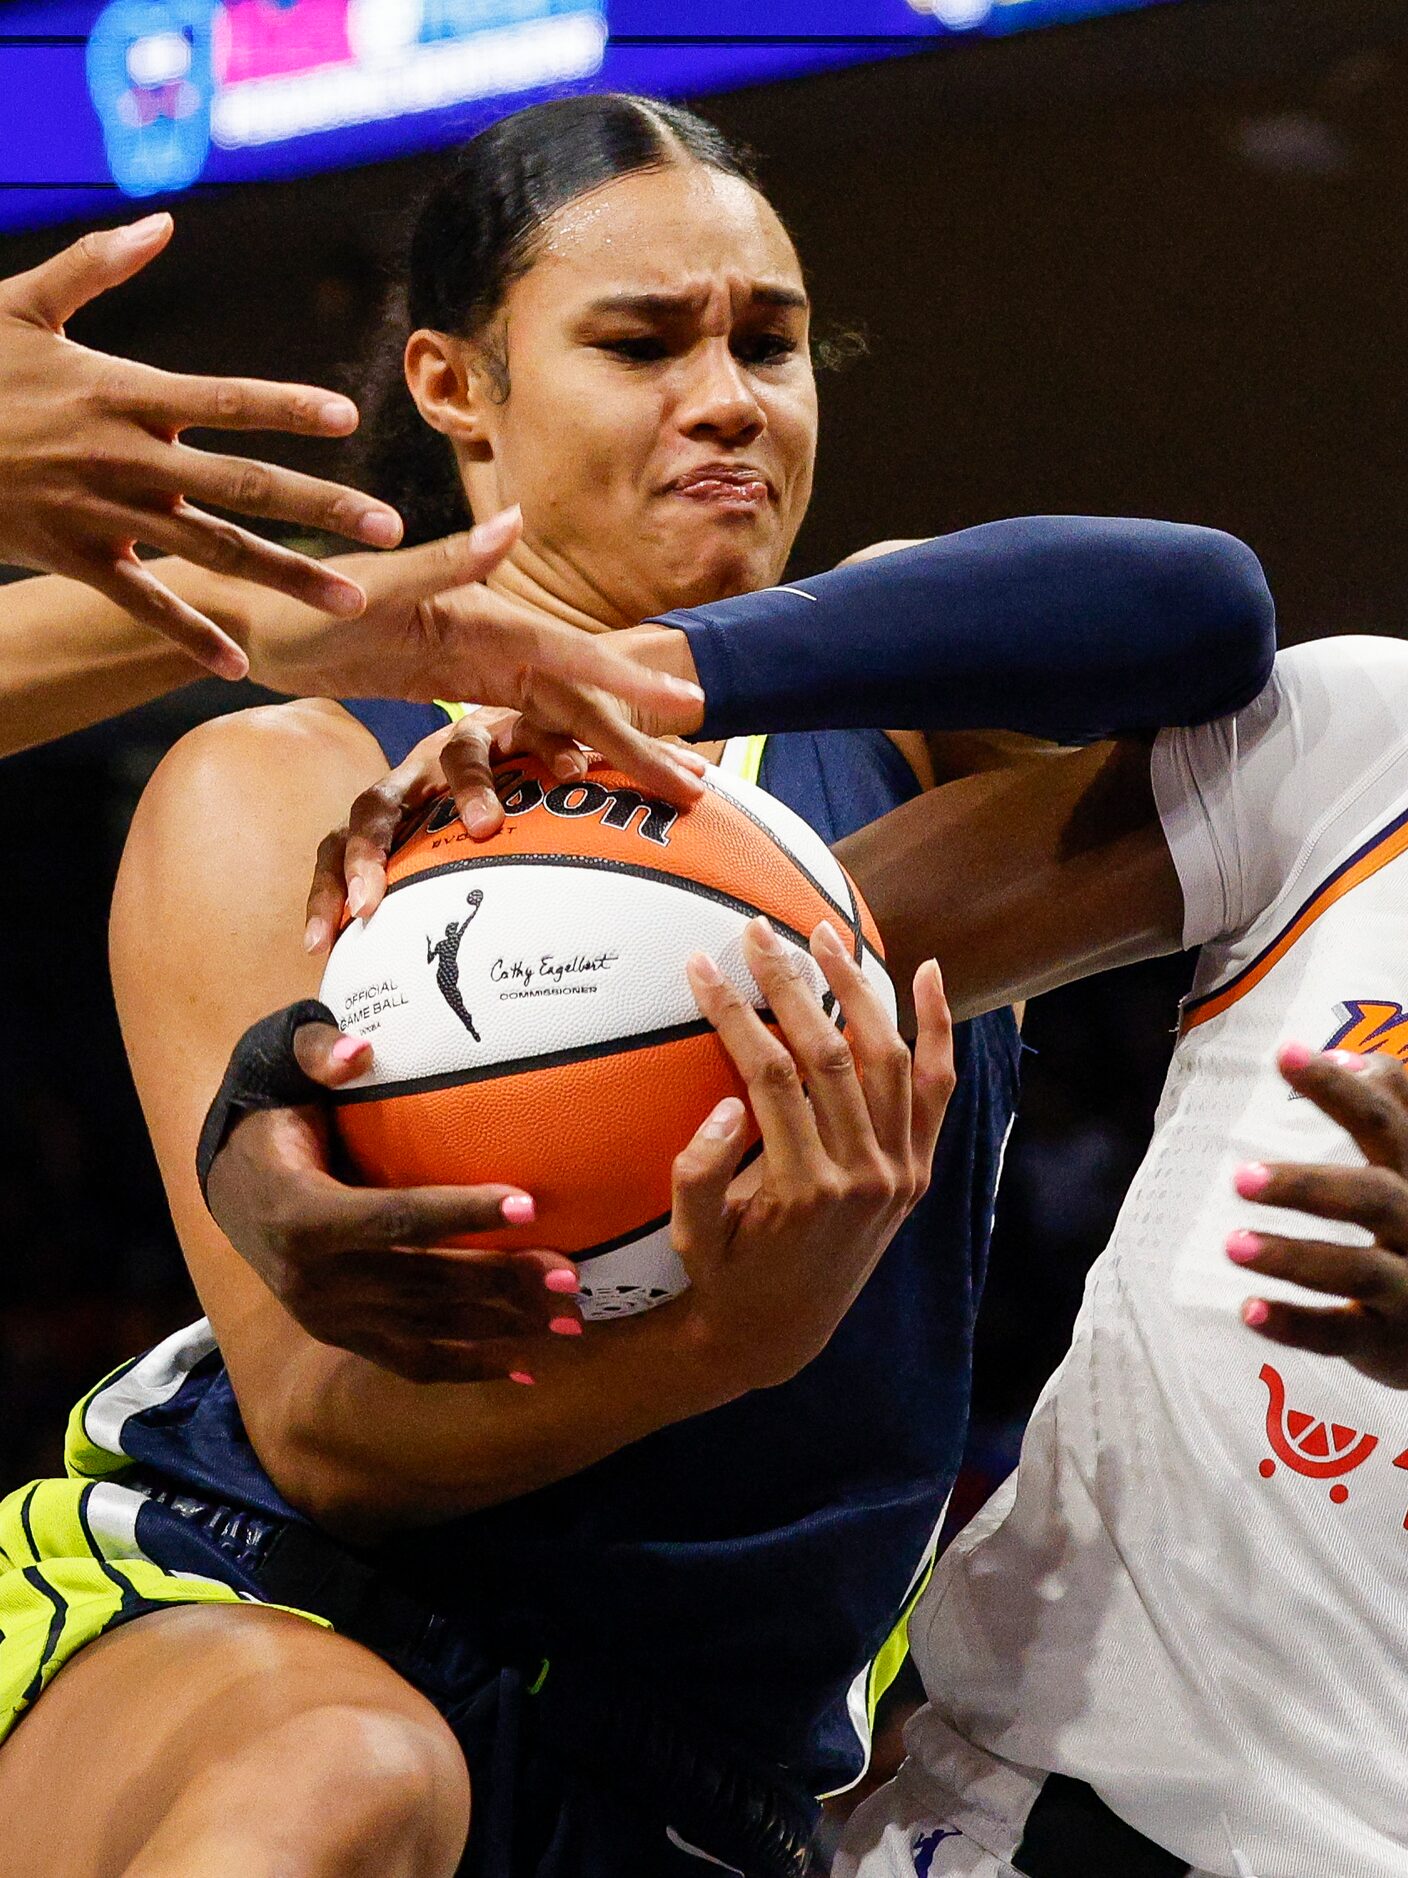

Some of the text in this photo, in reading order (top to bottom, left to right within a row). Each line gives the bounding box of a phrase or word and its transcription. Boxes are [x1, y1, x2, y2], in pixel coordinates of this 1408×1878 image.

[490, 958, 534, 987] Cathy
[344, 979, 398, 1010] OFFICIAL
[499, 985, 598, 1001] COMMISSIONER
[340, 993, 409, 1031] GAME BALL
